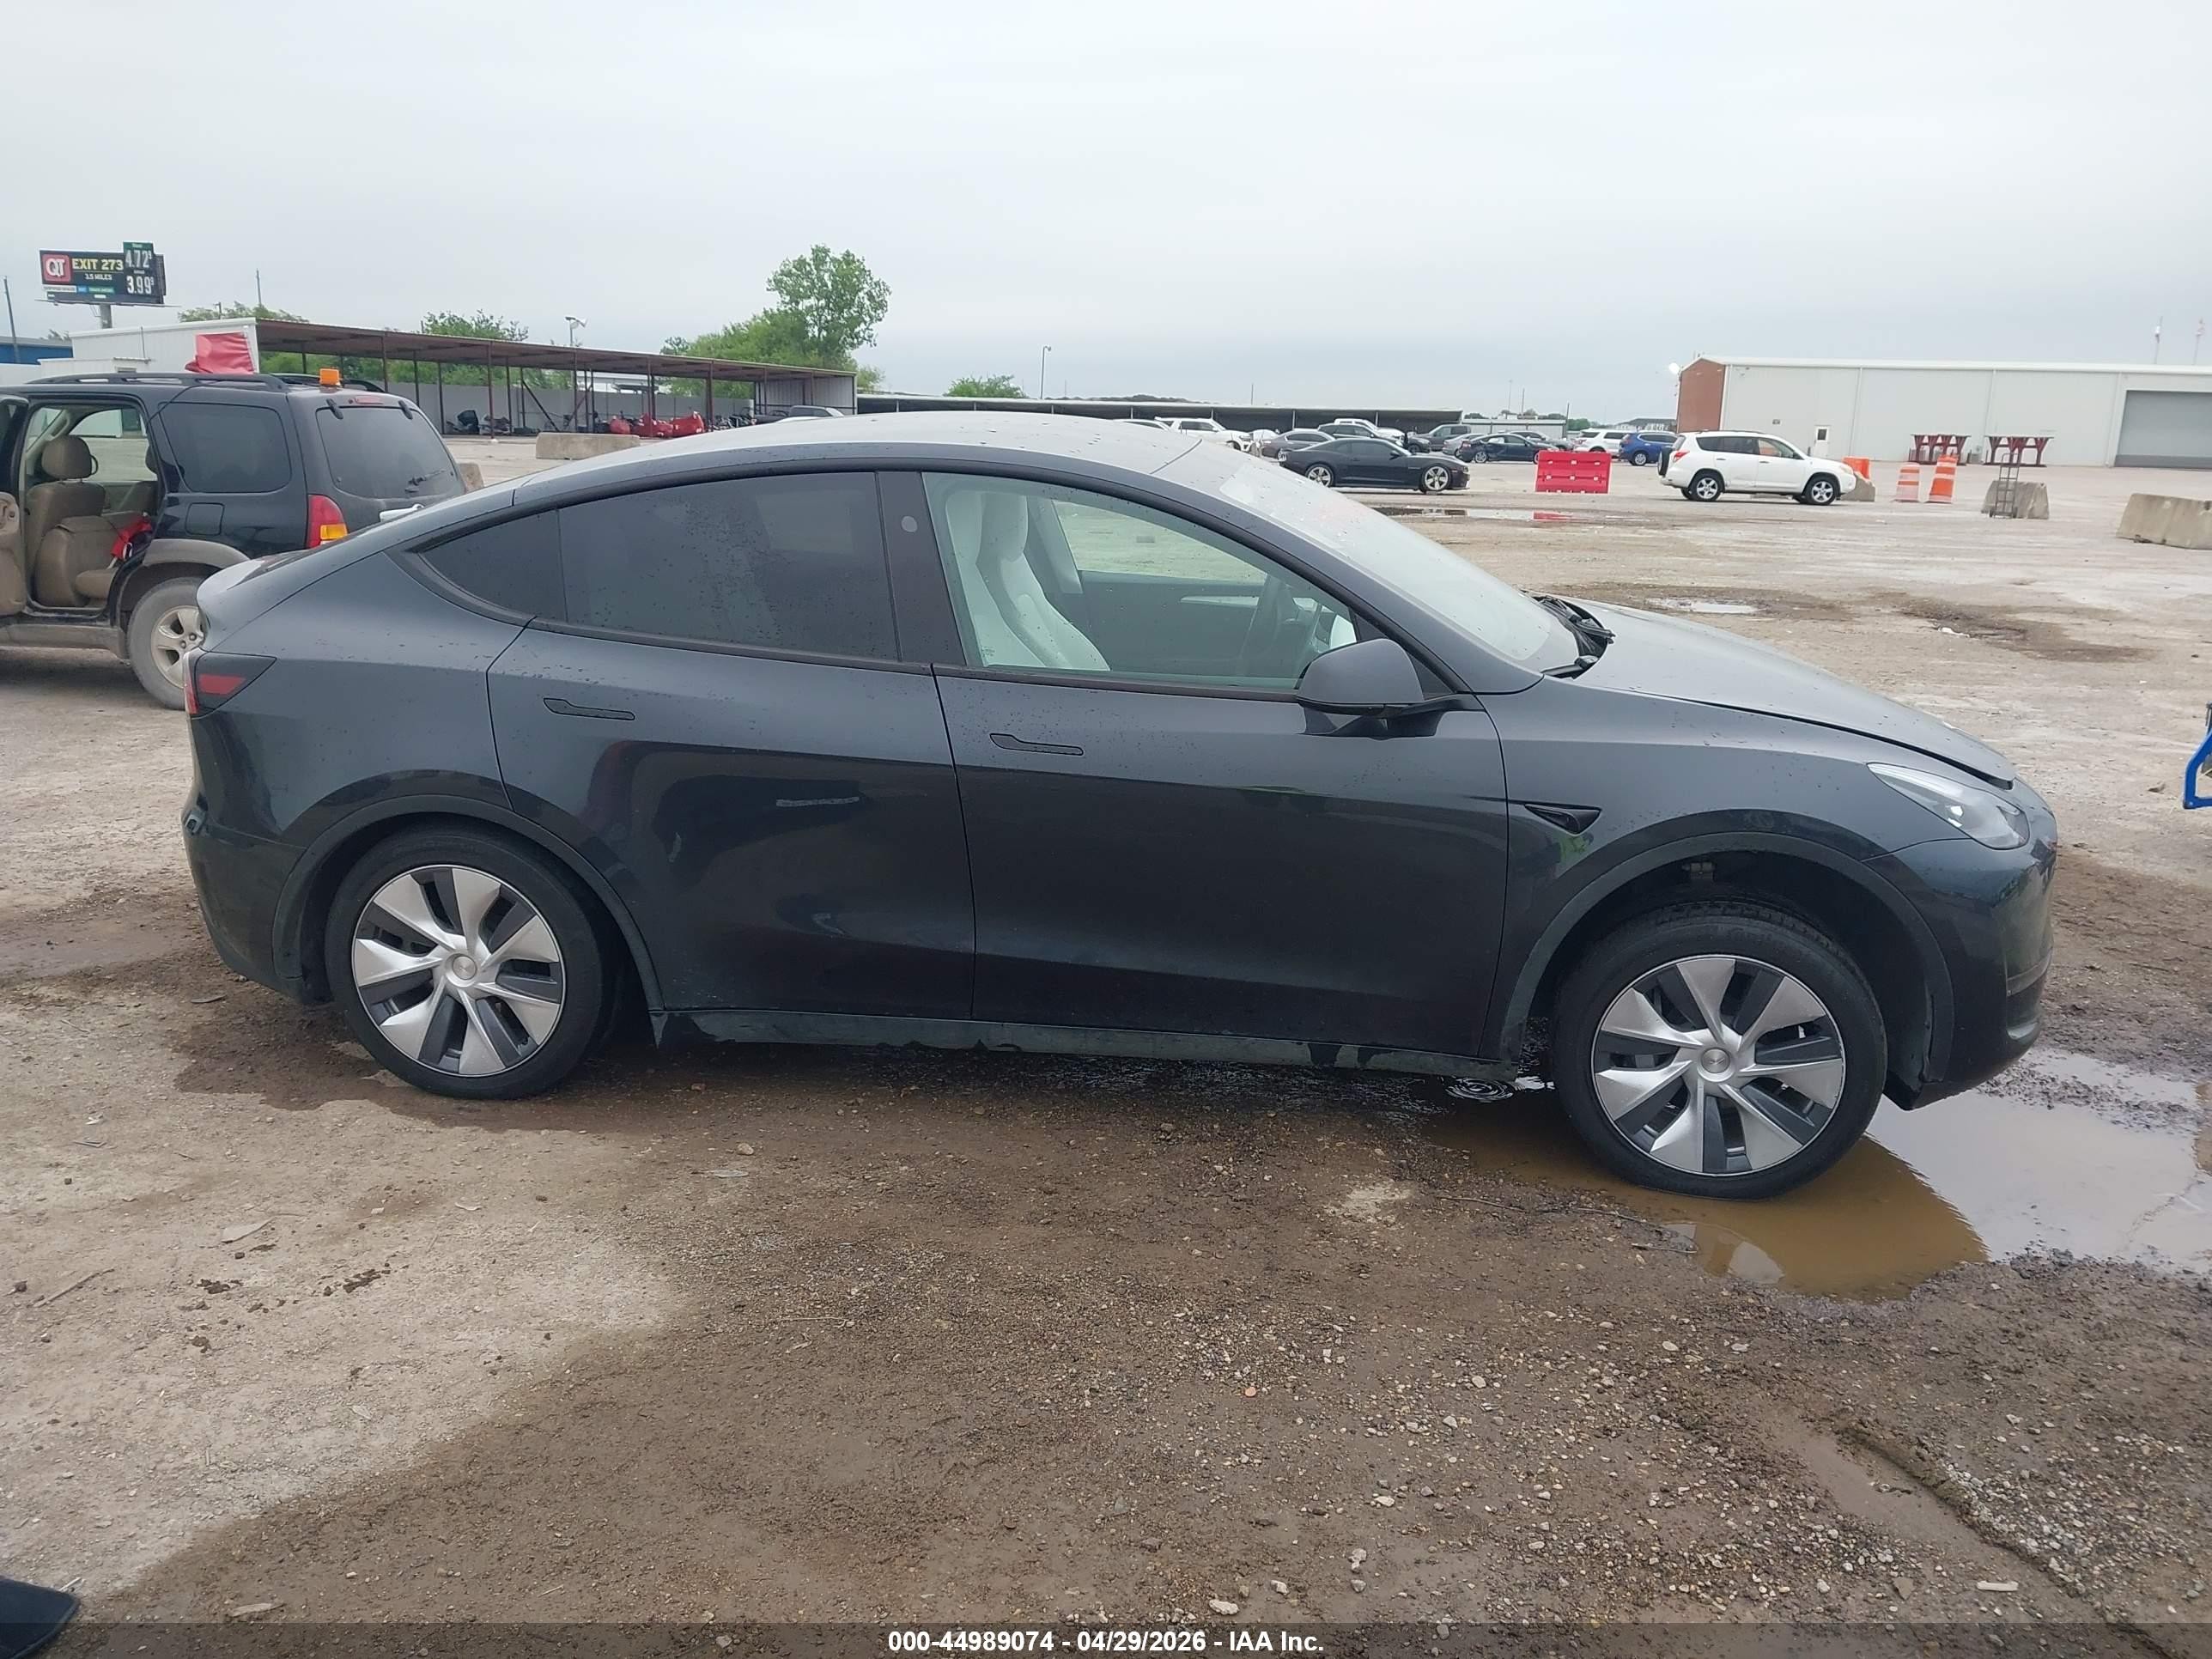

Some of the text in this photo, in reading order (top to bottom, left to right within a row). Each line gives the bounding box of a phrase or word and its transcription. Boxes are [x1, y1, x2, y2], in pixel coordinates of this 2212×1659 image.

[46, 258, 65, 276] QT
[72, 258, 124, 270] EXIT 273
